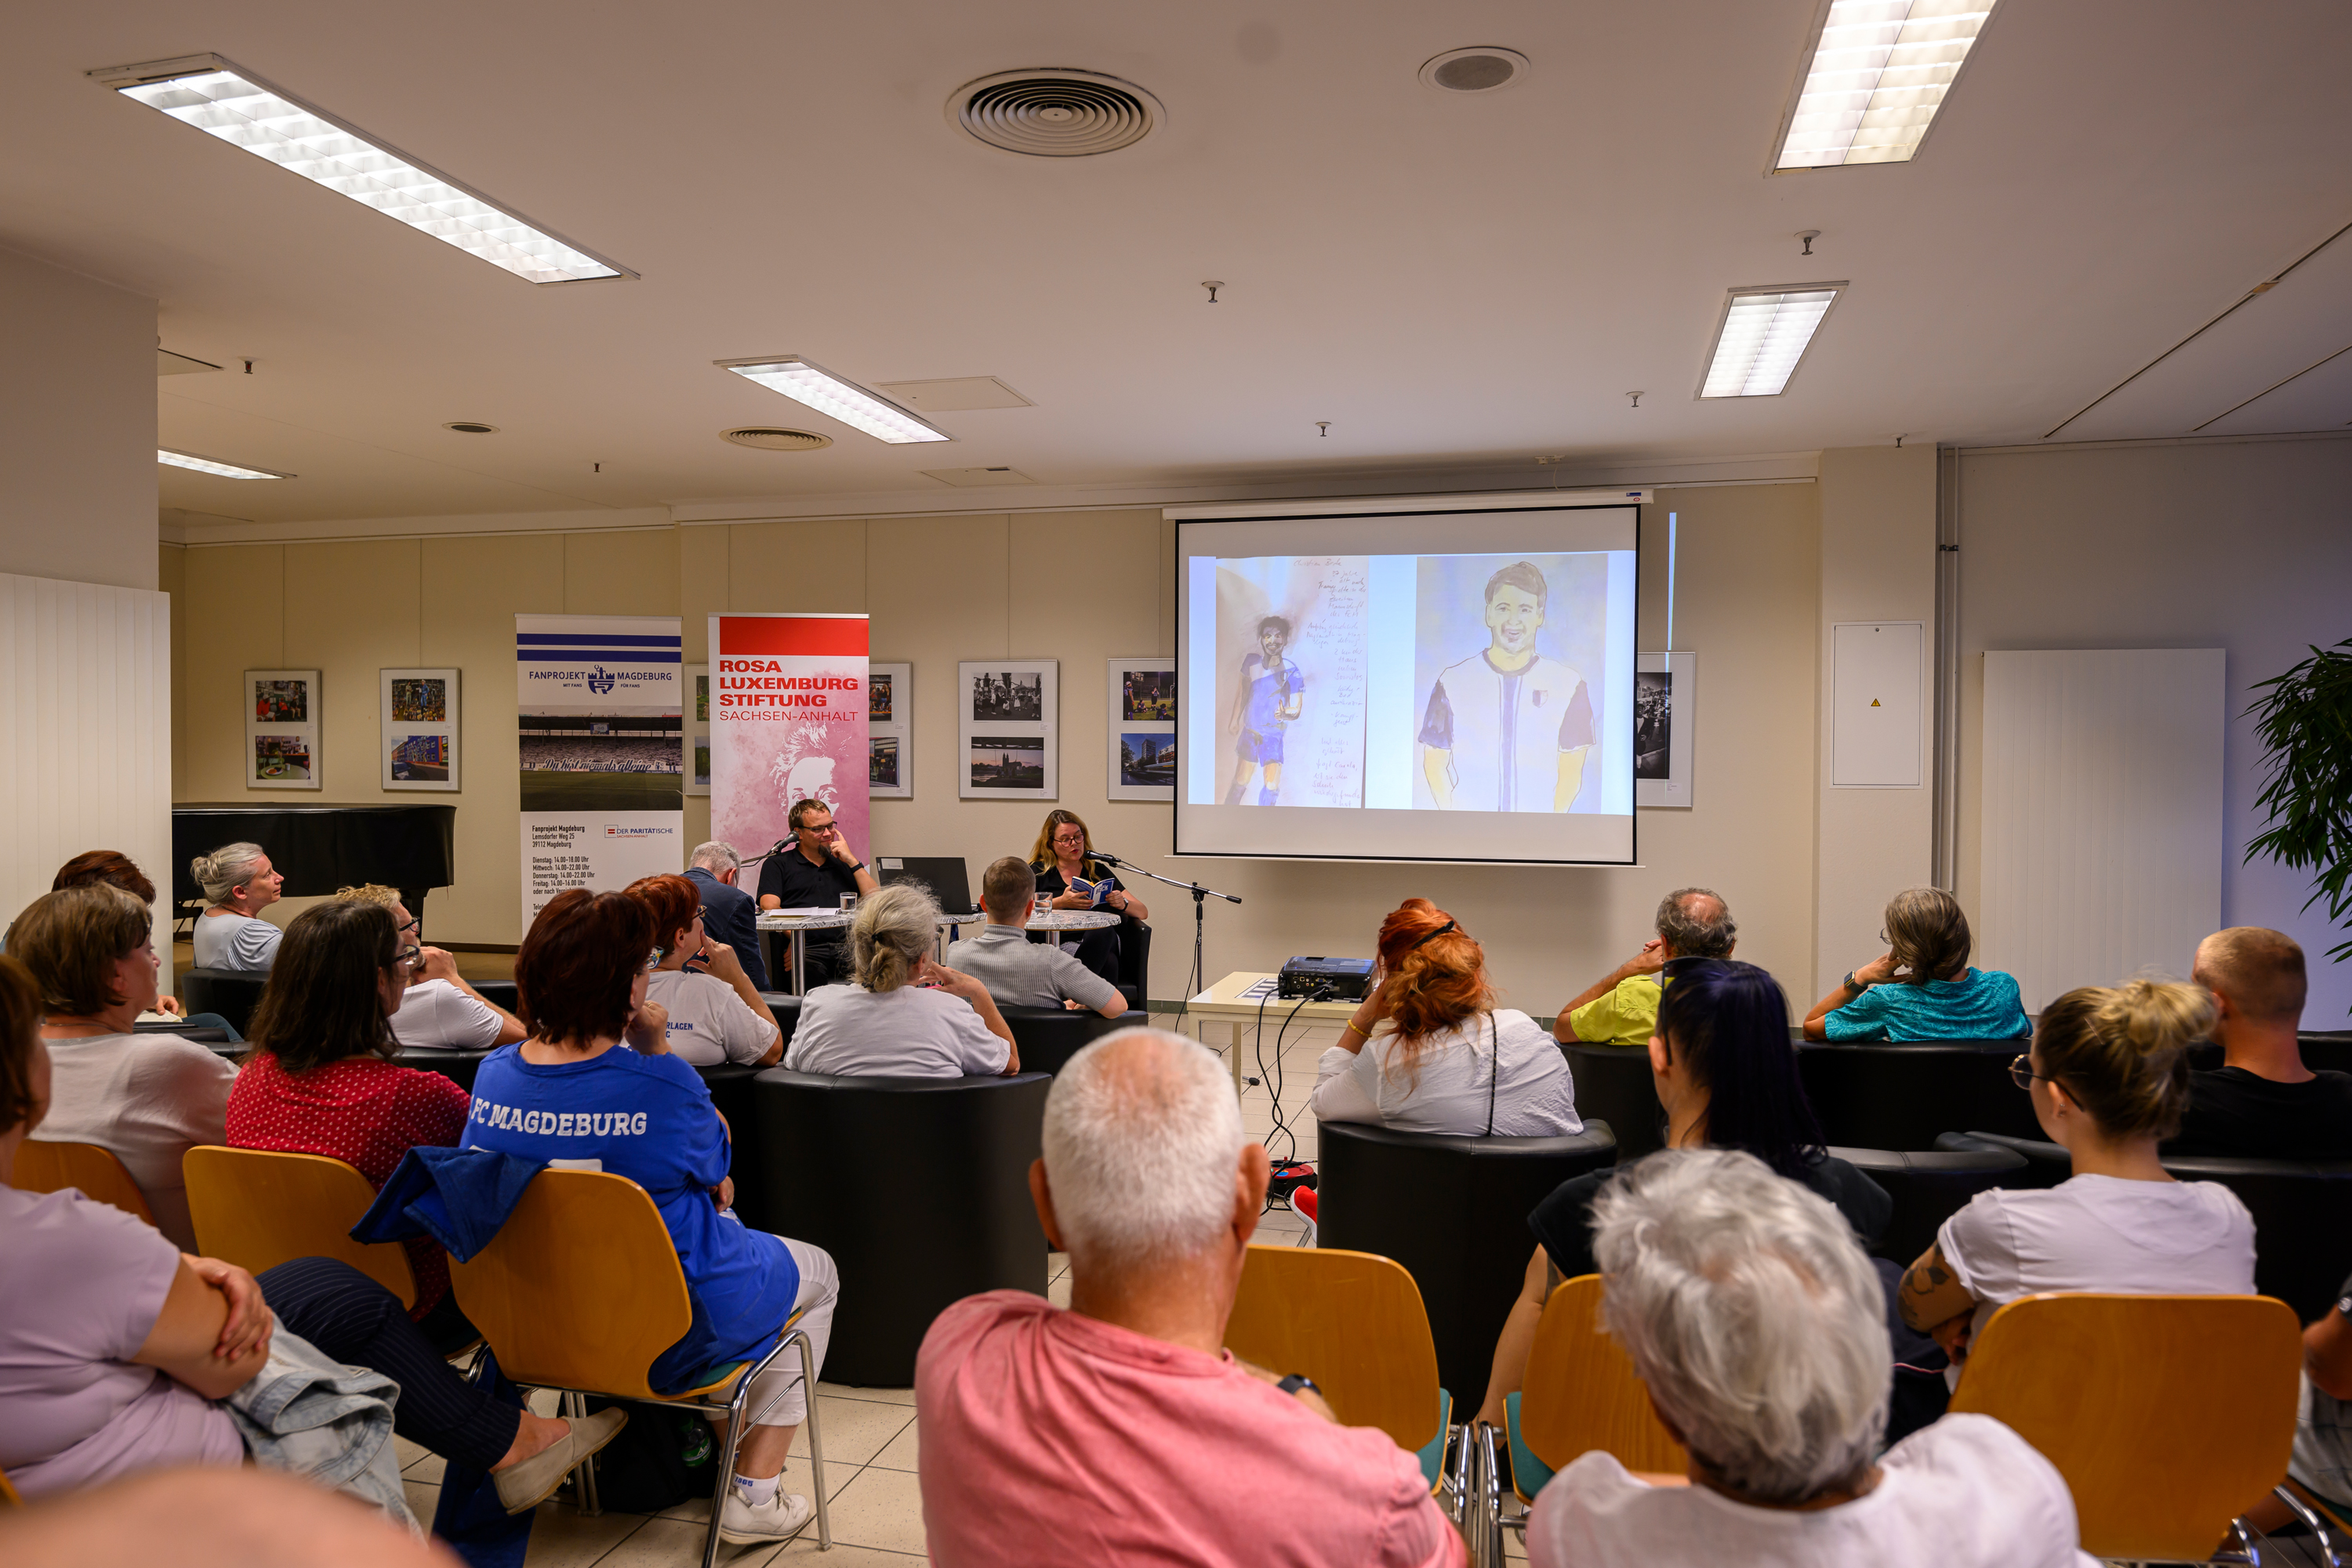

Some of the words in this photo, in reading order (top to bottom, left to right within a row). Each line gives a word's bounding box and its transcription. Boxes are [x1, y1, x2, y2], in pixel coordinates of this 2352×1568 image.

[720, 660, 782, 673] ROSA
[529, 671, 586, 680] FANPROJEKT
[617, 672, 672, 681] MAGDEBURG
[720, 677, 858, 690] LUXEMBURG
[720, 694, 827, 706] STIFTUNG
[720, 711, 858, 721] SACHSEN-ANHALT
[666, 1022, 693, 1030] RLAGEN
[470, 1098, 491, 1123] FC
[488, 1104, 648, 1136] MAGDEBURG
